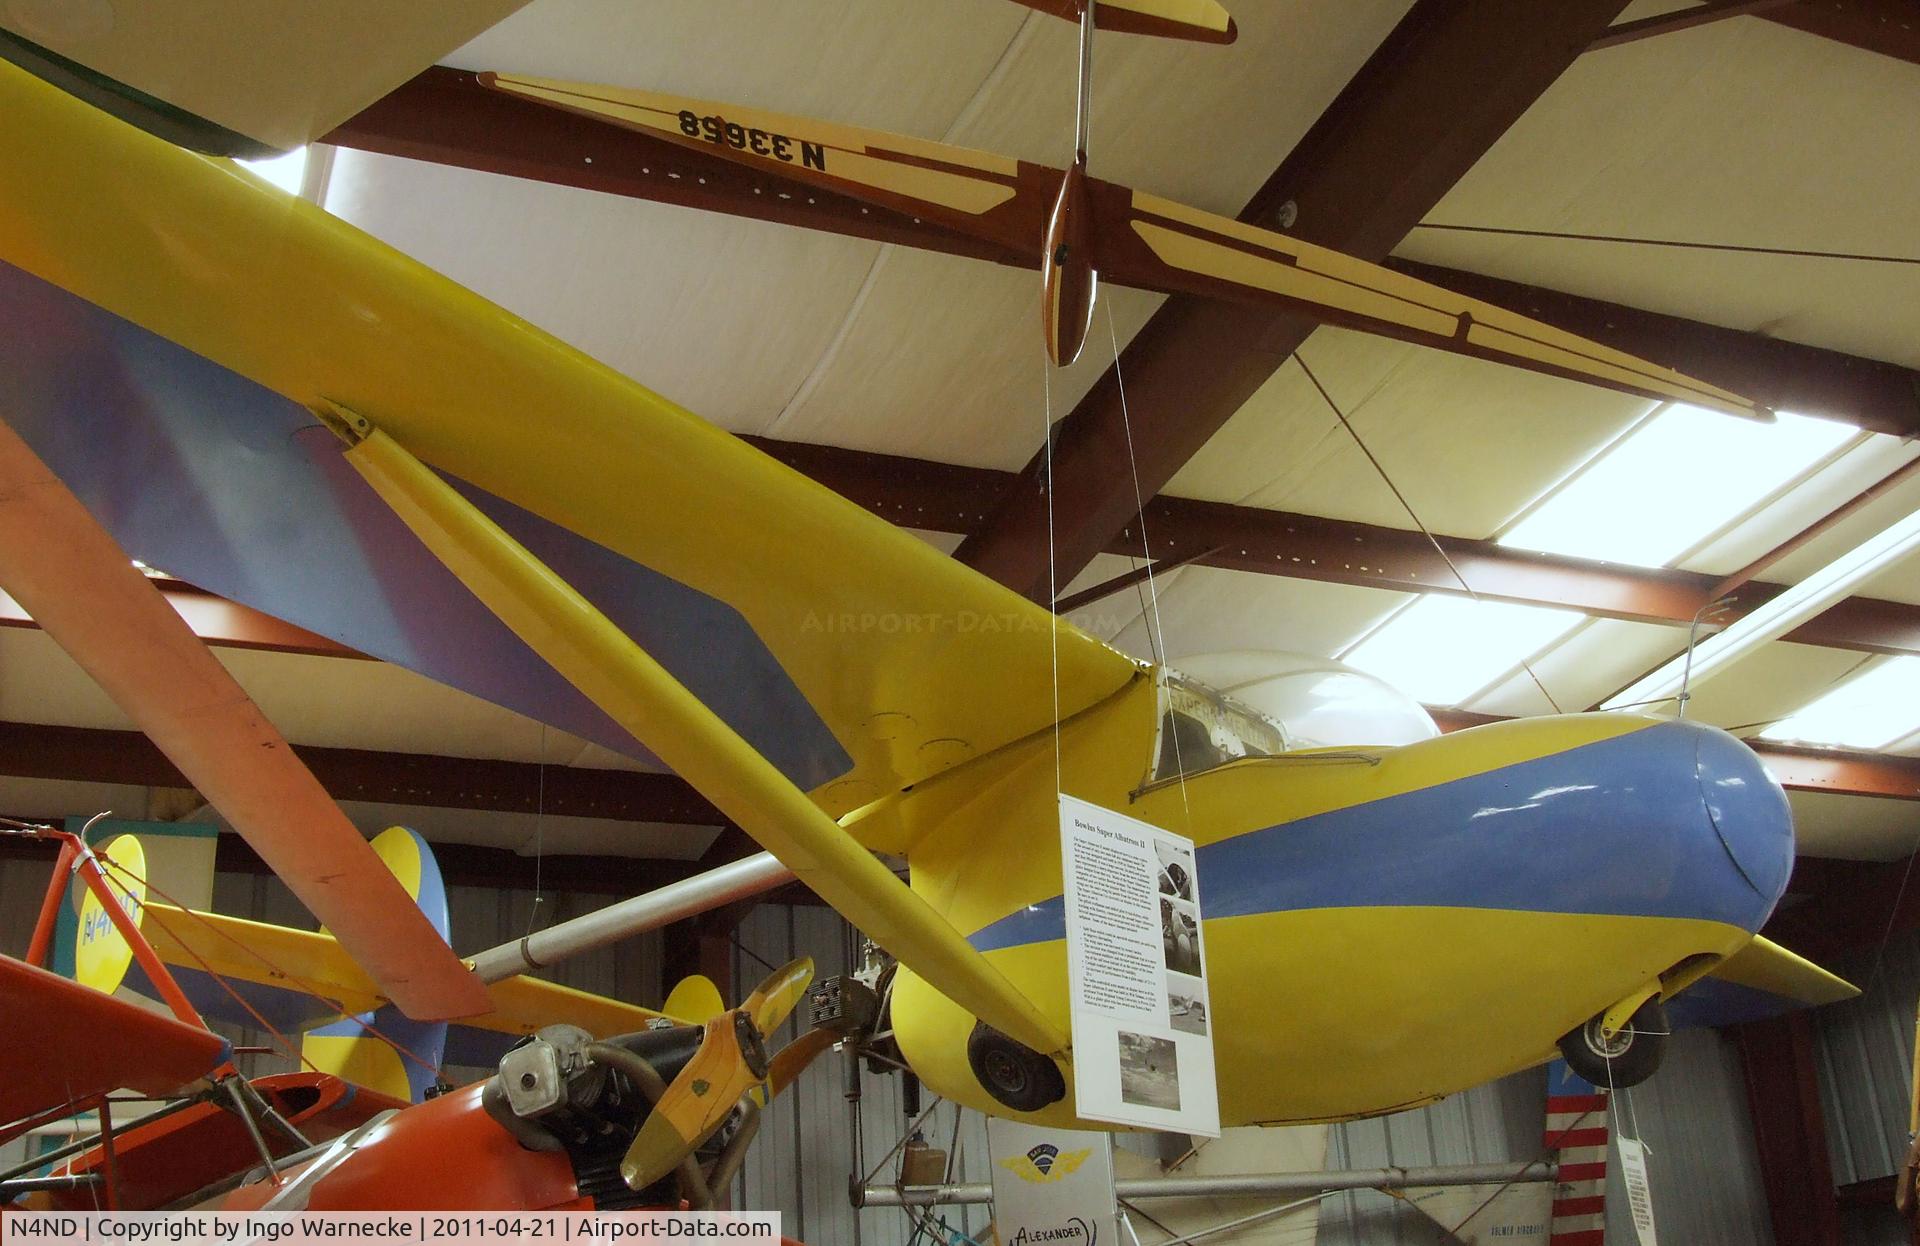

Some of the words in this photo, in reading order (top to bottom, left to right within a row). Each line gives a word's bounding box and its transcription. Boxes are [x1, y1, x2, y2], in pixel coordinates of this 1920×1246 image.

[678, 110, 794, 162] 33658
[801, 140, 826, 172] N
[1096, 825, 1114, 838] Super
[1114, 832, 1140, 846] Albatross
